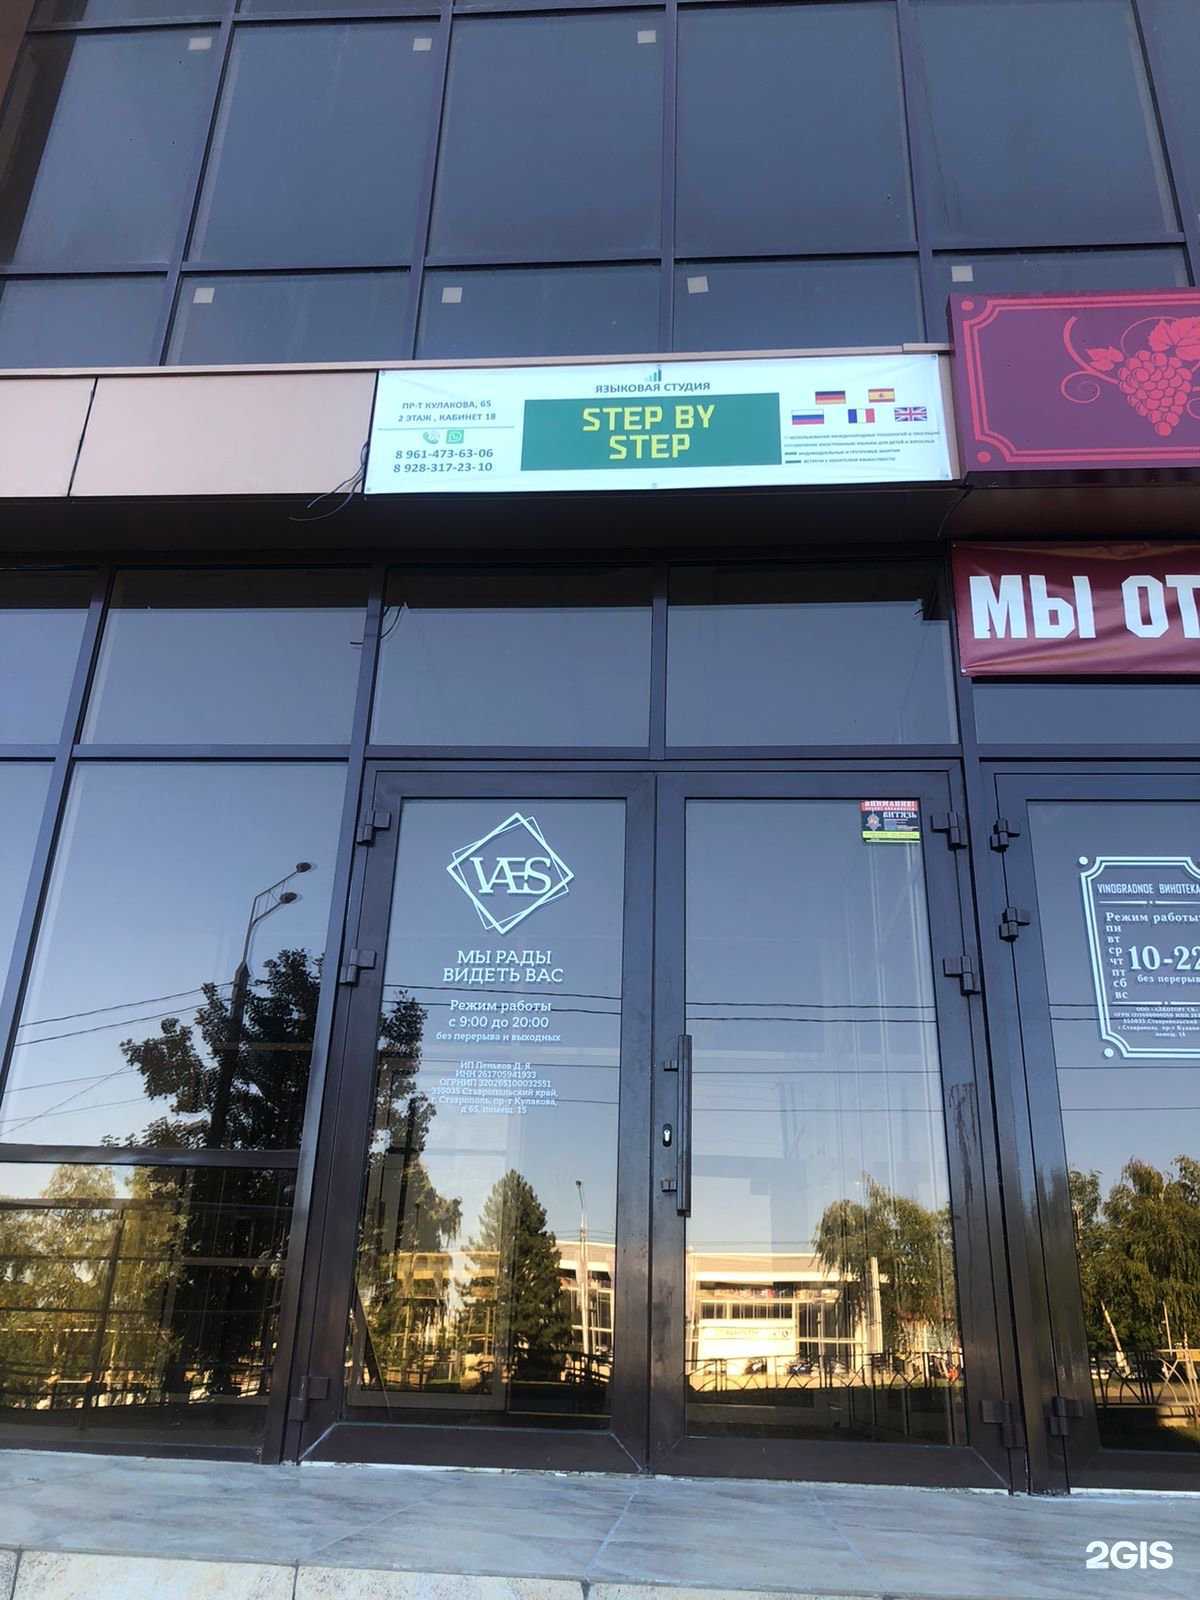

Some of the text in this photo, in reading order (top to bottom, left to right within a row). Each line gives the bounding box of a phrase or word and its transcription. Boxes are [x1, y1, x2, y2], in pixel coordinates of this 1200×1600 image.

[595, 382, 710, 393] ЯЗЫКОВАЯ СТУДИЯ
[425, 400, 478, 409] КУЛАКОВА,
[439, 413, 482, 421] КАБИНЕТ
[583, 404, 715, 431] STEP BY
[609, 434, 690, 459] STEP
[395, 449, 493, 459] 8 961-473-63-06
[393, 462, 492, 473] 8 928-317-23-10
[969, 575, 1200, 638] МЫ ОТ
[1097, 883, 1154, 894] VINOGRADNOE
[1105, 912, 1149, 922] Режим
[1109, 947, 1122, 957] ср
[457, 950, 552, 966] МЫ РАДЫ
[443, 968, 564, 984] ВИДЕТЬ ВАС
[1137, 974, 1154, 982] без
[1113, 978, 1127, 987] сб
[1115, 991, 1128, 999] вс
[450, 1000, 551, 1014] Режим работы
[448, 1016, 549, 1029] с 9:00 до 20:00
[436, 1032, 453, 1040] без
[454, 1033, 500, 1042] перерыва
[511, 1034, 561, 1042] выходных
